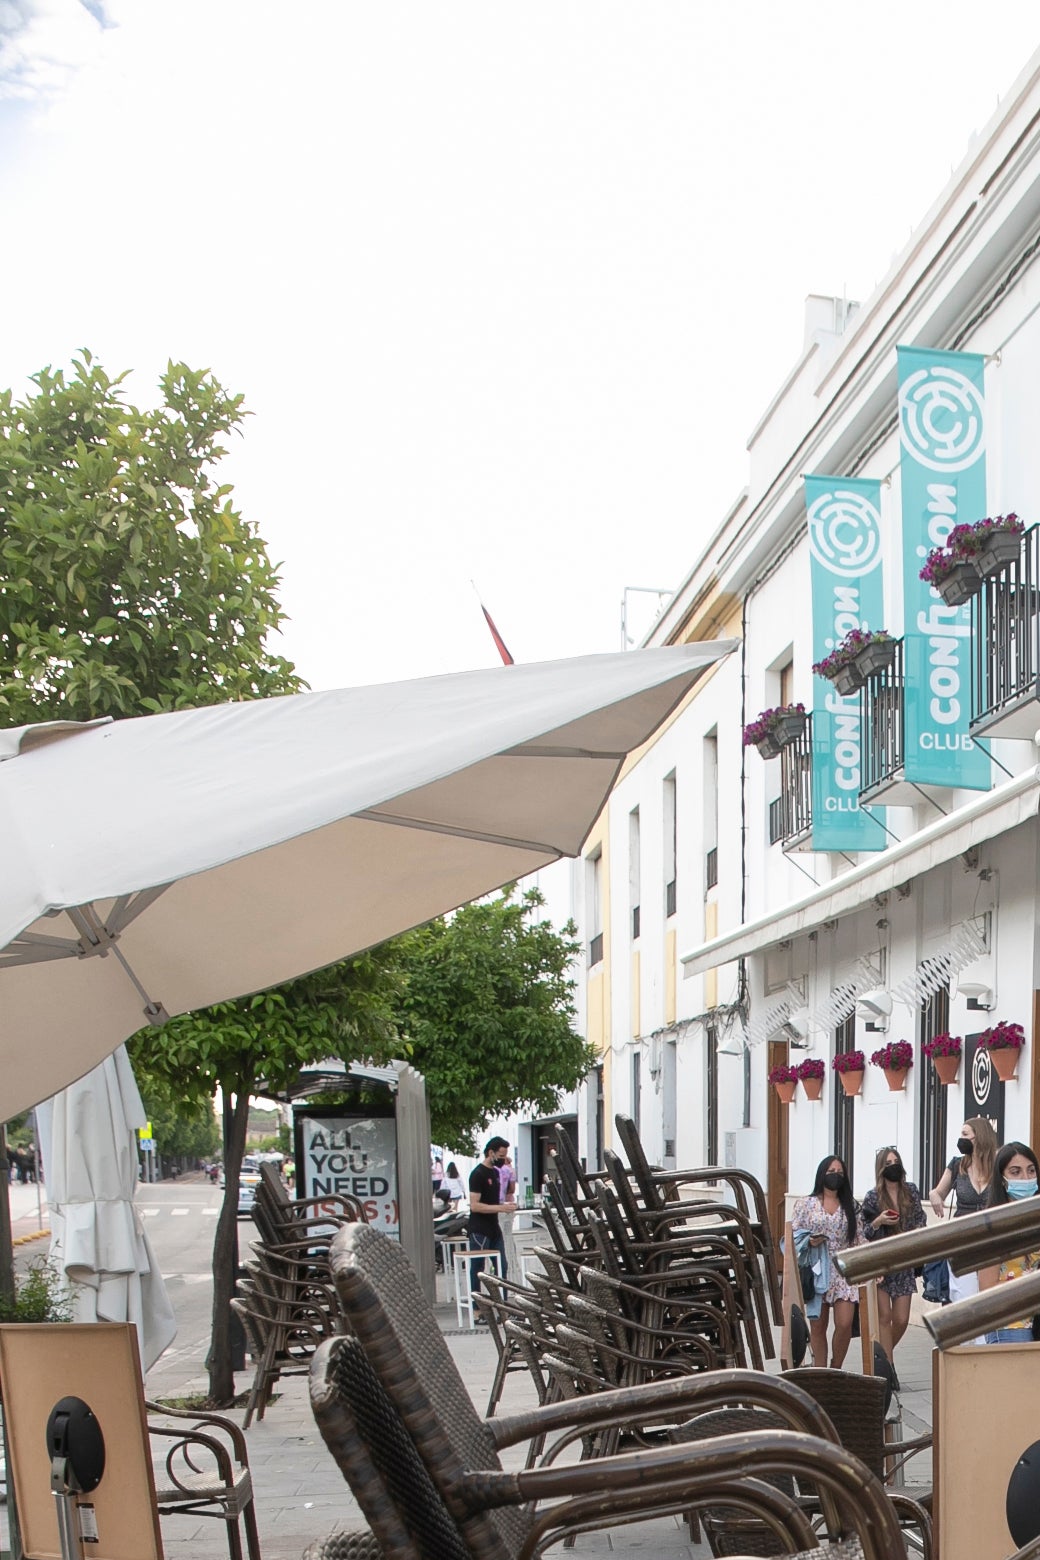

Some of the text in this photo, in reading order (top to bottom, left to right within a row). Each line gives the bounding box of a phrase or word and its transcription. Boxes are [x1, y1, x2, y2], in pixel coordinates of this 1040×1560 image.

[919, 732, 975, 751] CLUB
[825, 797, 872, 812] CLU
[309, 1131, 361, 1151] ALL
[309, 1154, 368, 1174] YOU
[312, 1177, 389, 1197] NEED
